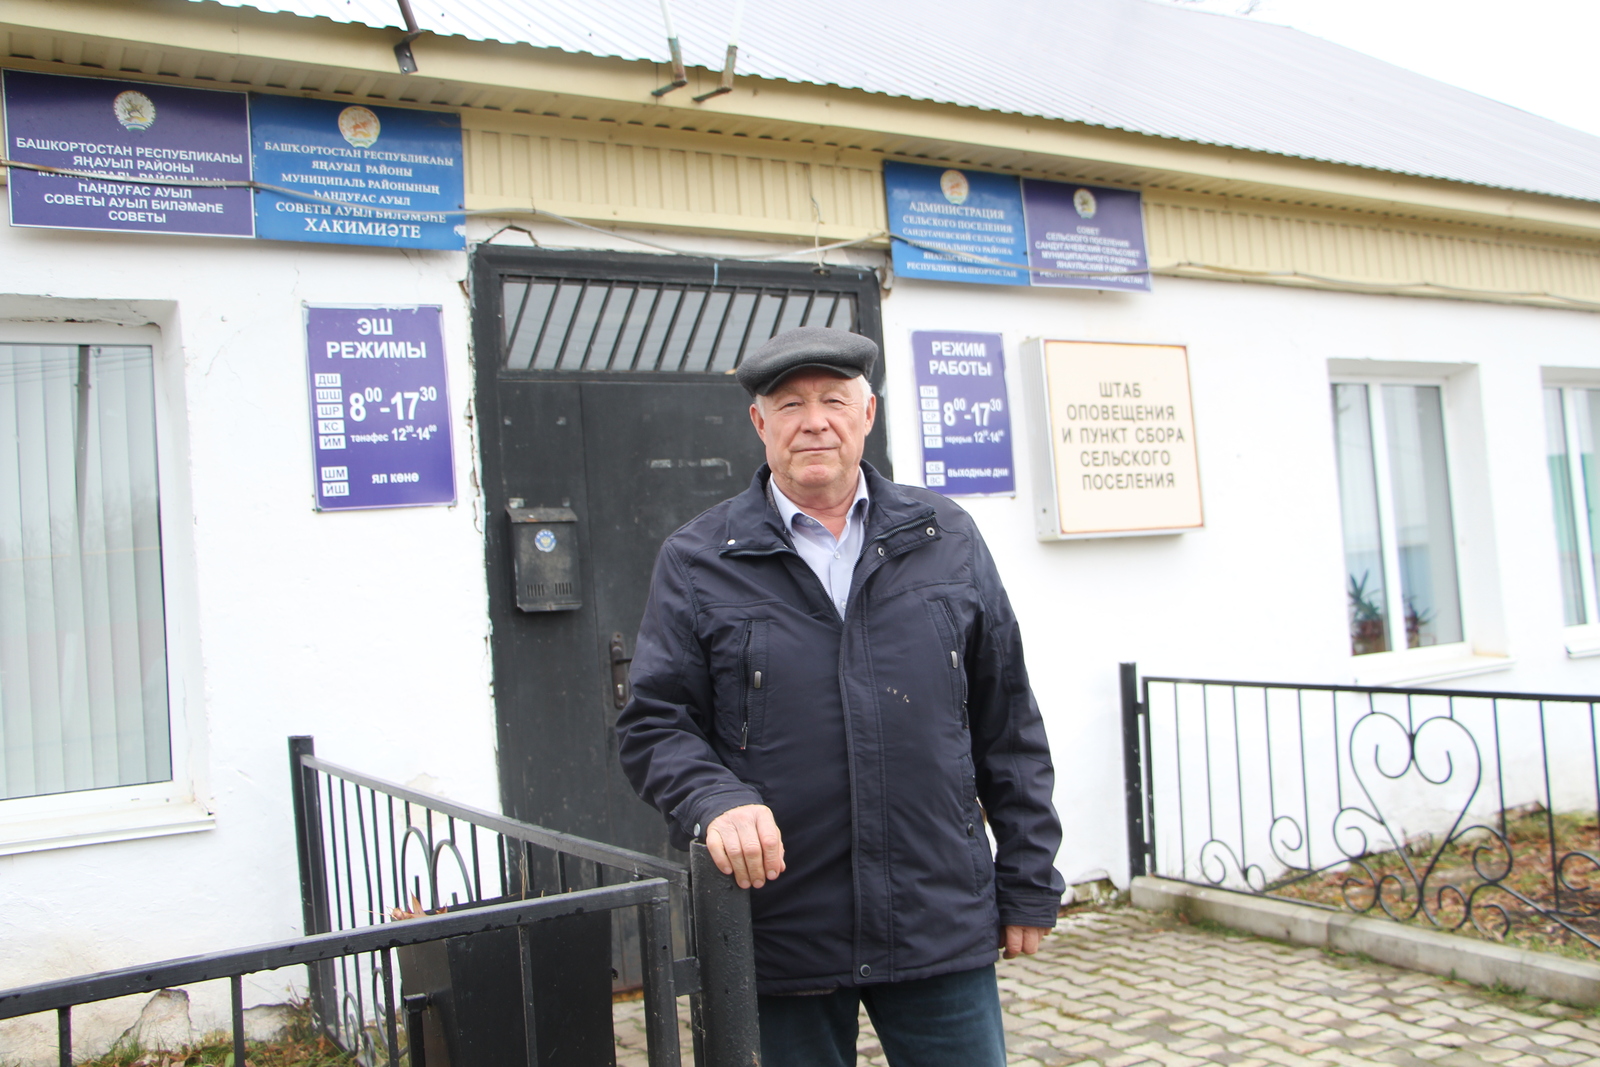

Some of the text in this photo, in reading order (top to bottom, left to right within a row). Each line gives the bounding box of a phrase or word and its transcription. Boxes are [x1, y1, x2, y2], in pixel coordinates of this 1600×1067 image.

[136, 147, 243, 164] РЕСПУБЛИКАҺЫ
[364, 151, 454, 167] РЕСПУБЛИКАҺЫ
[73, 155, 194, 174] ЯҢАУЫЛ РАЙОНЫ
[312, 160, 413, 177] ЯҢАУЫЛ РАЙОНЫ
[78, 182, 192, 199] ҺАНДУҒАС АУЫЛ
[281, 173, 440, 195] МУНИЦИПАЛЬ РАЙОНЫНЫҢ
[44, 193, 224, 214] СОВЕТЫ АУЫЛ БИЛӘМӘҺЕ
[379, 195, 411, 206] АУЫЛ
[109, 210, 167, 223] СОВЕТЫ
[276, 202, 331, 215] СОВЕТЫ
[335, 205, 372, 218] АУЫЛ
[909, 201, 1005, 219] АДМИНИСТРАЦИЯ
[304, 217, 422, 238] ХАКИМИӘТЕ
[902, 215, 1013, 234] СЕЛЬСКОГО ПОСЕЛЕНИЯ
[357, 318, 393, 335] ЭШ
[326, 341, 427, 358] РЕЖИМЫ
[931, 341, 986, 357] РЕЖИМ
[929, 360, 993, 376] РАБОТЫ
[318, 375, 338, 386] ДШ
[318, 391, 341, 400] ШШ
[1099, 382, 1142, 398] ШТАБ
[321, 406, 340, 416] ШР
[1066, 404, 1176, 423] ОПОВЕЩЕНИЯ
[324, 421, 339, 431] КС
[1062, 427, 1185, 444] И ПУНКТ СБОРА
[1080, 450, 1171, 467] СЕЛЬСКОГО
[324, 468, 345, 478] ШМ
[929, 464, 941, 472] СБ
[1082, 473, 1176, 490] ПОСЕЛЕНИЯ
